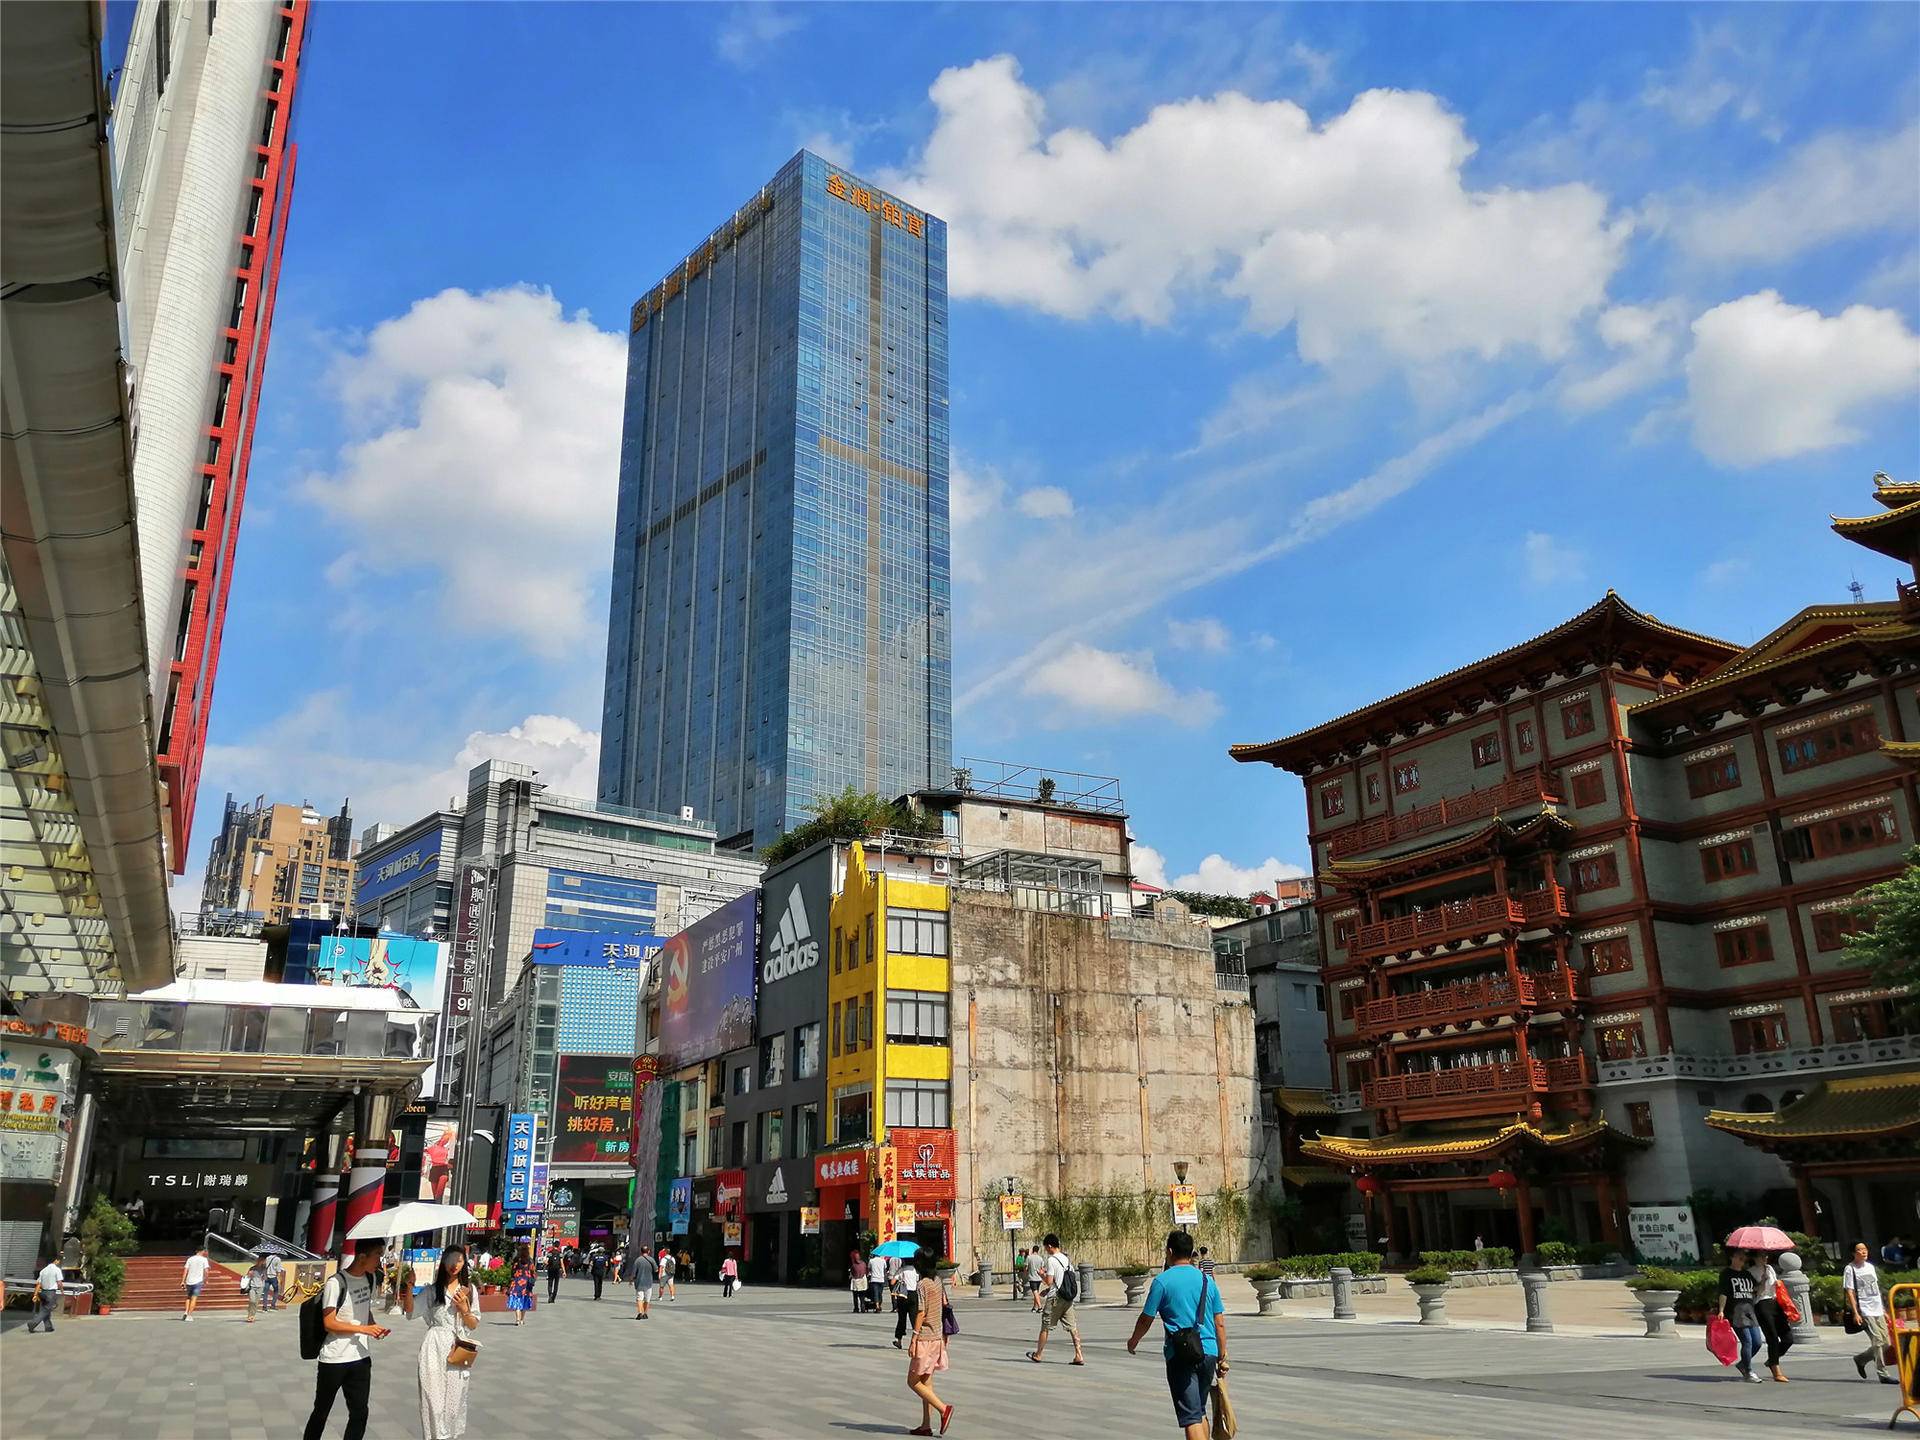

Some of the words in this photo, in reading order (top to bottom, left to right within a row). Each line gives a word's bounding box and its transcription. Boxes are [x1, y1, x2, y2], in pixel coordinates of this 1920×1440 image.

[763, 939, 819, 984] adidas
[574, 1095, 632, 1111] 听好声音
[508, 1120, 531, 1203] 天河城百货
[148, 1175, 193, 1186] TSL
